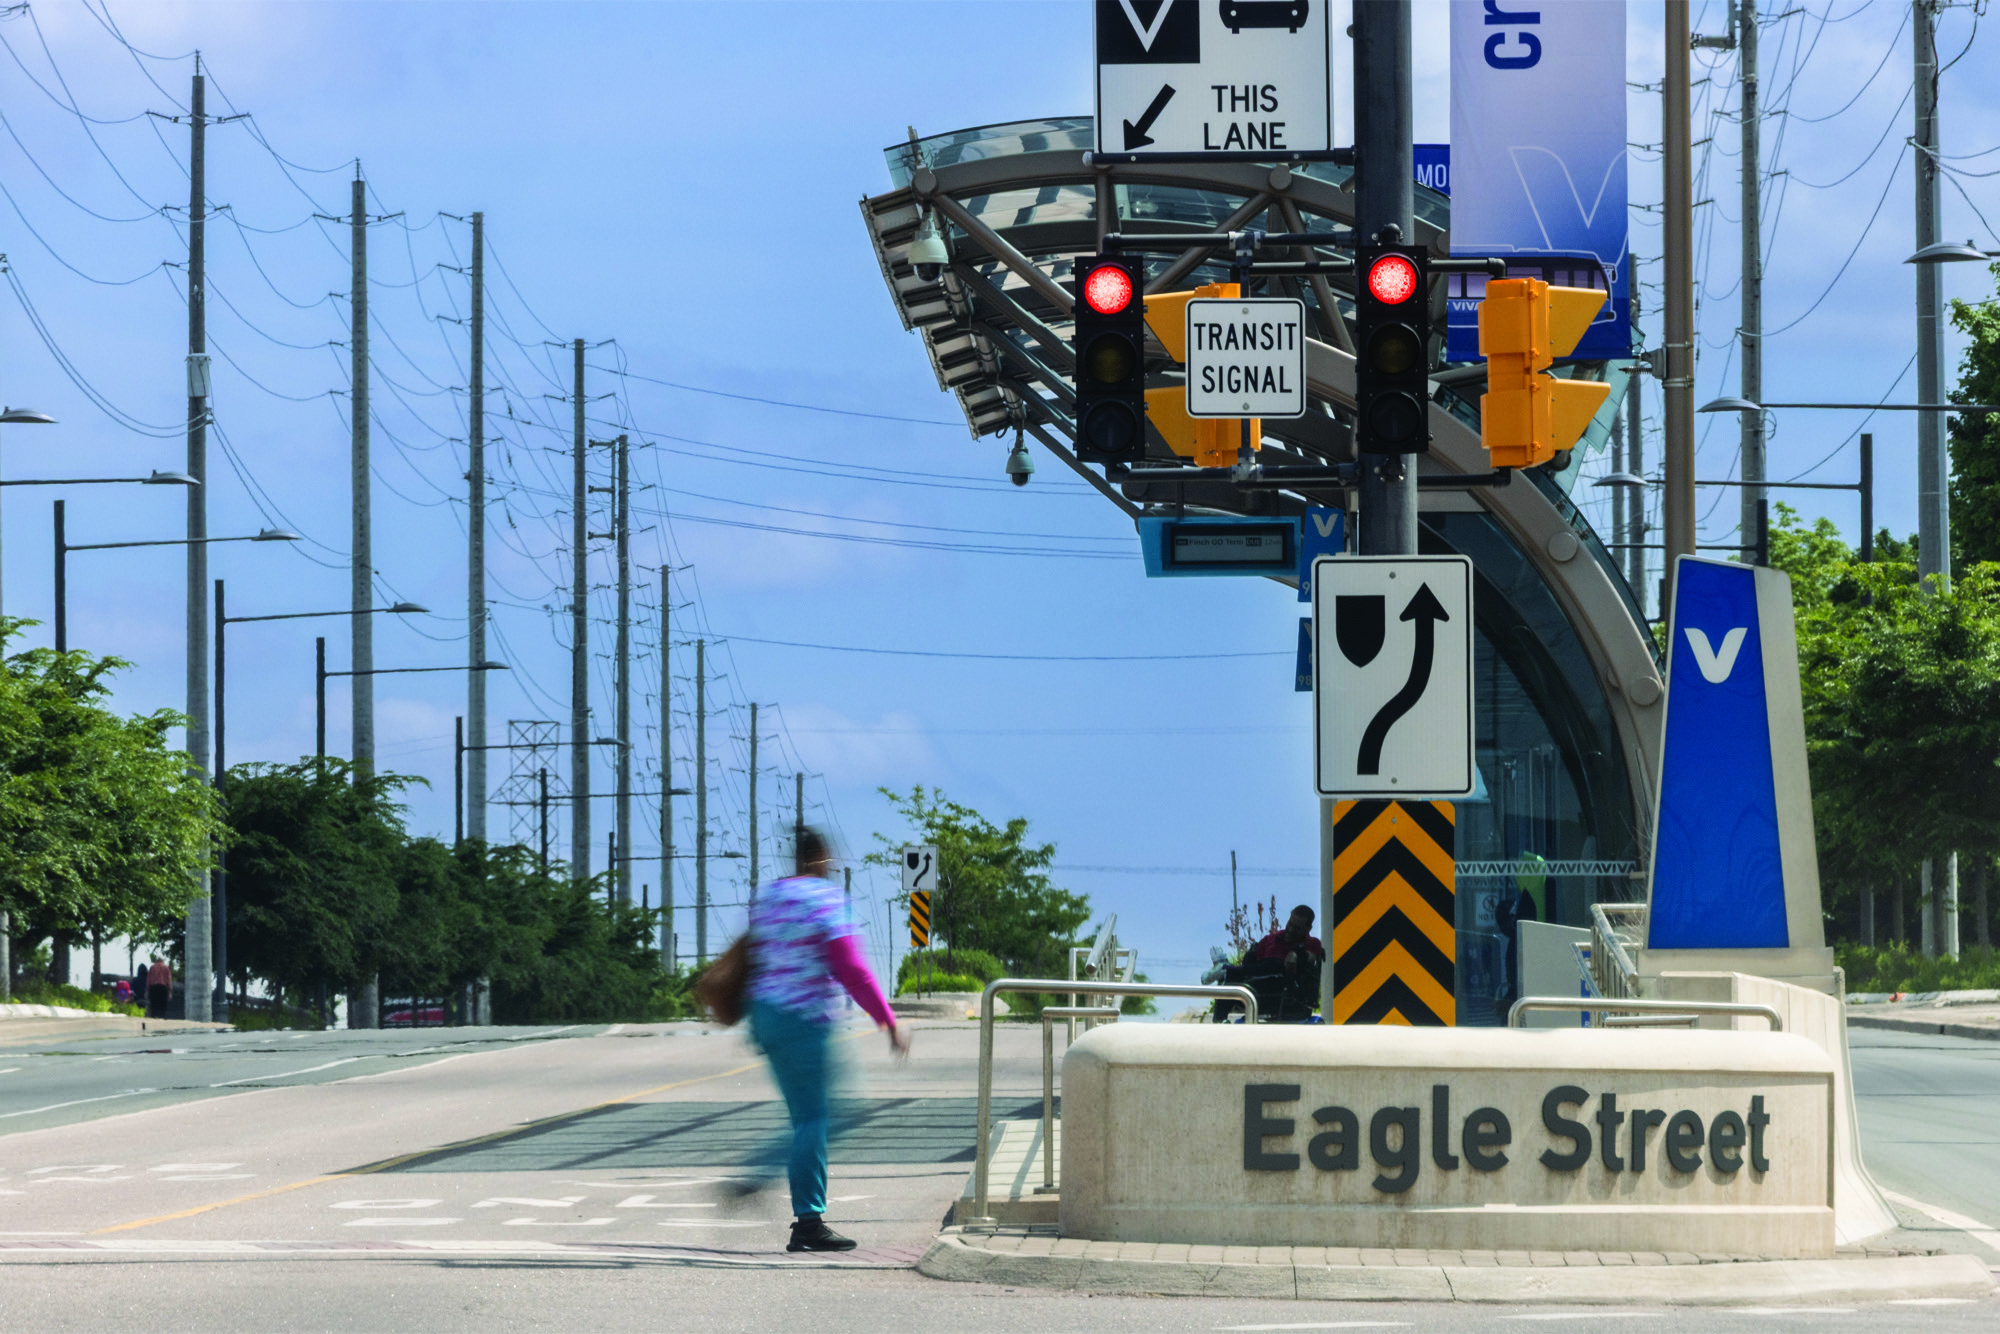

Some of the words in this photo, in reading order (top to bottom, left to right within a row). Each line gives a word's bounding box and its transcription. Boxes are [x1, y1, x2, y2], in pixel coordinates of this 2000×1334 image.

[1211, 84, 1279, 113] THIS
[1203, 122, 1287, 150] LANE
[1194, 322, 1297, 350] TRANSIT
[1201, 365, 1292, 394] SIGNAL
[1244, 1084, 1512, 1194] Eagle
[1539, 1085, 1770, 1172] Street
